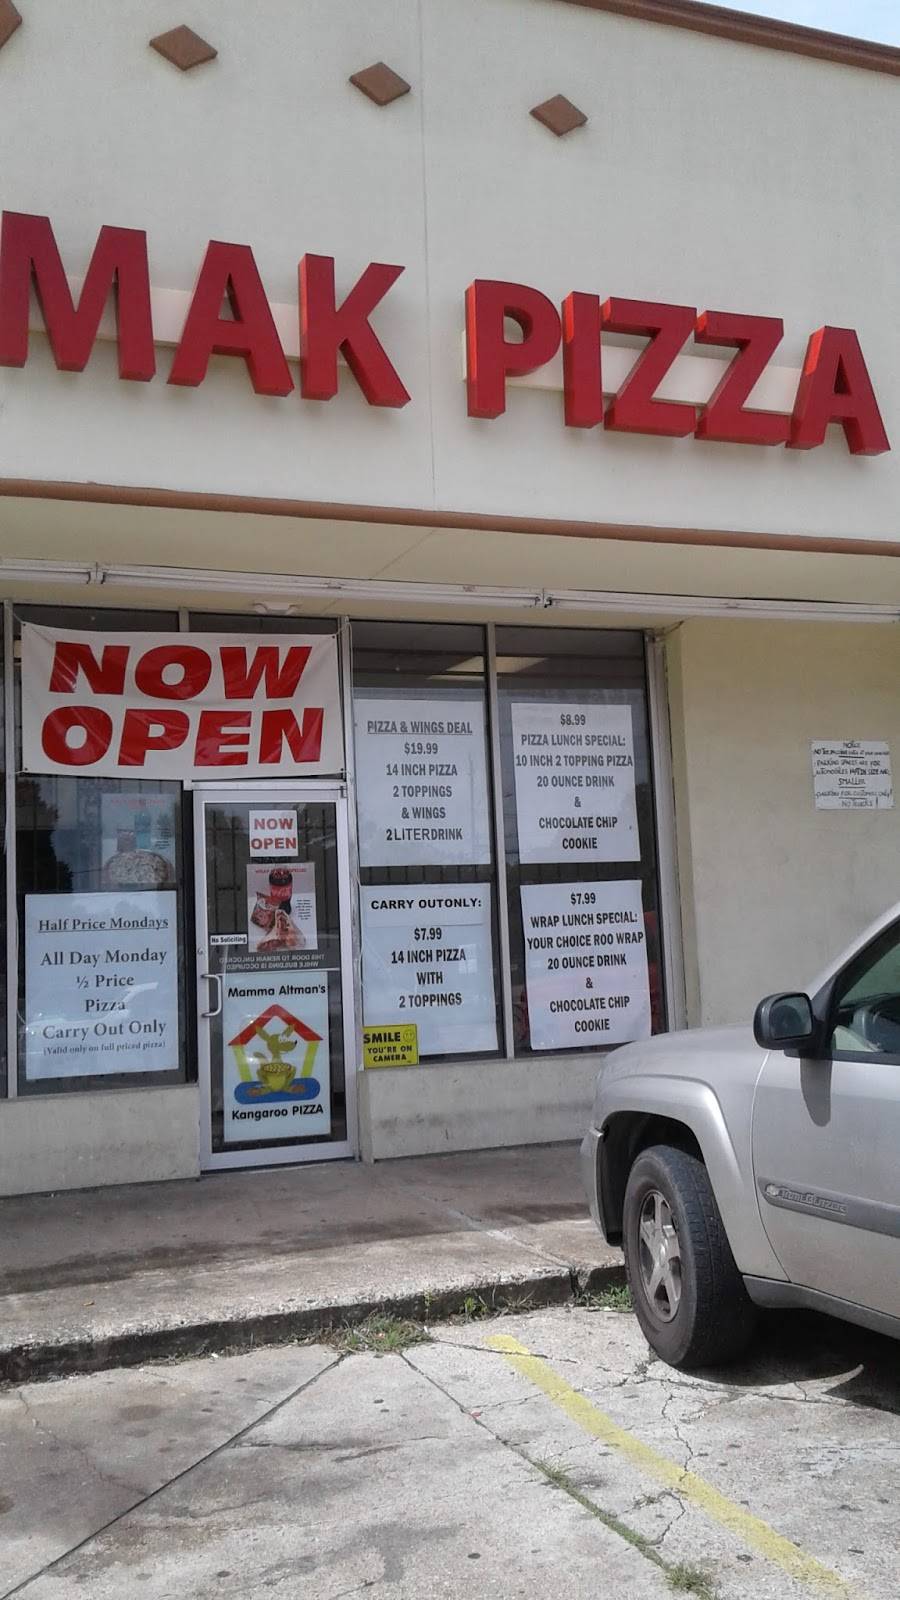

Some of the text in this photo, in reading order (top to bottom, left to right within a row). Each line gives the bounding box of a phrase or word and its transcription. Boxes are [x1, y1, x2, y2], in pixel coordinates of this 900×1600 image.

[0, 210, 891, 456] MAK PIZZA
[49, 641, 312, 700] NOW
[560, 714, 586, 726] $8.99
[367, 721, 472, 734] PIZZA & WINGS DEAL
[41, 705, 325, 767] OPEN
[521, 734, 626, 746] PIZZA LUNCH SPECIAL:
[404, 742, 438, 756] $19.99
[516, 755, 633, 766] 10 INCH 2 TOPPING PIZZA
[386, 764, 458, 776] 14 INCH PIZZA
[537, 776, 615, 787] 20 OUNCE DRINK
[393, 786, 452, 798] 2 TOPPINGS
[574, 796, 581, 807] &
[401, 807, 446, 819] & WINGS
[254, 818, 294, 830] NOW
[538, 816, 618, 829] CHOCOLATE CHIP
[386, 828, 393, 841] 2
[251, 838, 297, 849] OPEN
[562, 838, 598, 849] COOKIE
[371, 900, 414, 910] CARRY
[570, 892, 596, 906] $7.99
[38, 916, 169, 931] Half Price Mondays
[530, 911, 638, 928] WRAP LUNCH SPECIAL:
[414, 927, 442, 941] $7.99
[527, 932, 644, 950] YOUR CHOICE ROO WRAP
[40, 948, 167, 967] All Day Monday
[391, 948, 466, 964] 14 INCH PIZZA
[547, 954, 627, 970] 20 OUNCE DRINK
[95, 974, 135, 987] Price
[416, 971, 443, 985] WITH
[585, 977, 593, 989] &
[228, 984, 326, 997] Mamma Altman's
[85, 999, 126, 1012] Pizza
[399, 992, 462, 1008] 2 TOPPINGS
[550, 996, 630, 1013] CHOCOLATE CHIP
[43, 1019, 167, 1041] Carry Out Only
[574, 1019, 610, 1032] COOKIE
[363, 1032, 401, 1044] SMILE
[69, 1044, 86, 1054] only
[101, 1043, 115, 1051] full
[116, 1041, 141, 1051] priced
[142, 1041, 165, 1050] pizza)
[367, 1046, 397, 1054] YOU'RE
[373, 1054, 407, 1062] CAMERA
[232, 1104, 324, 1121] Kangaroo PIZZA
